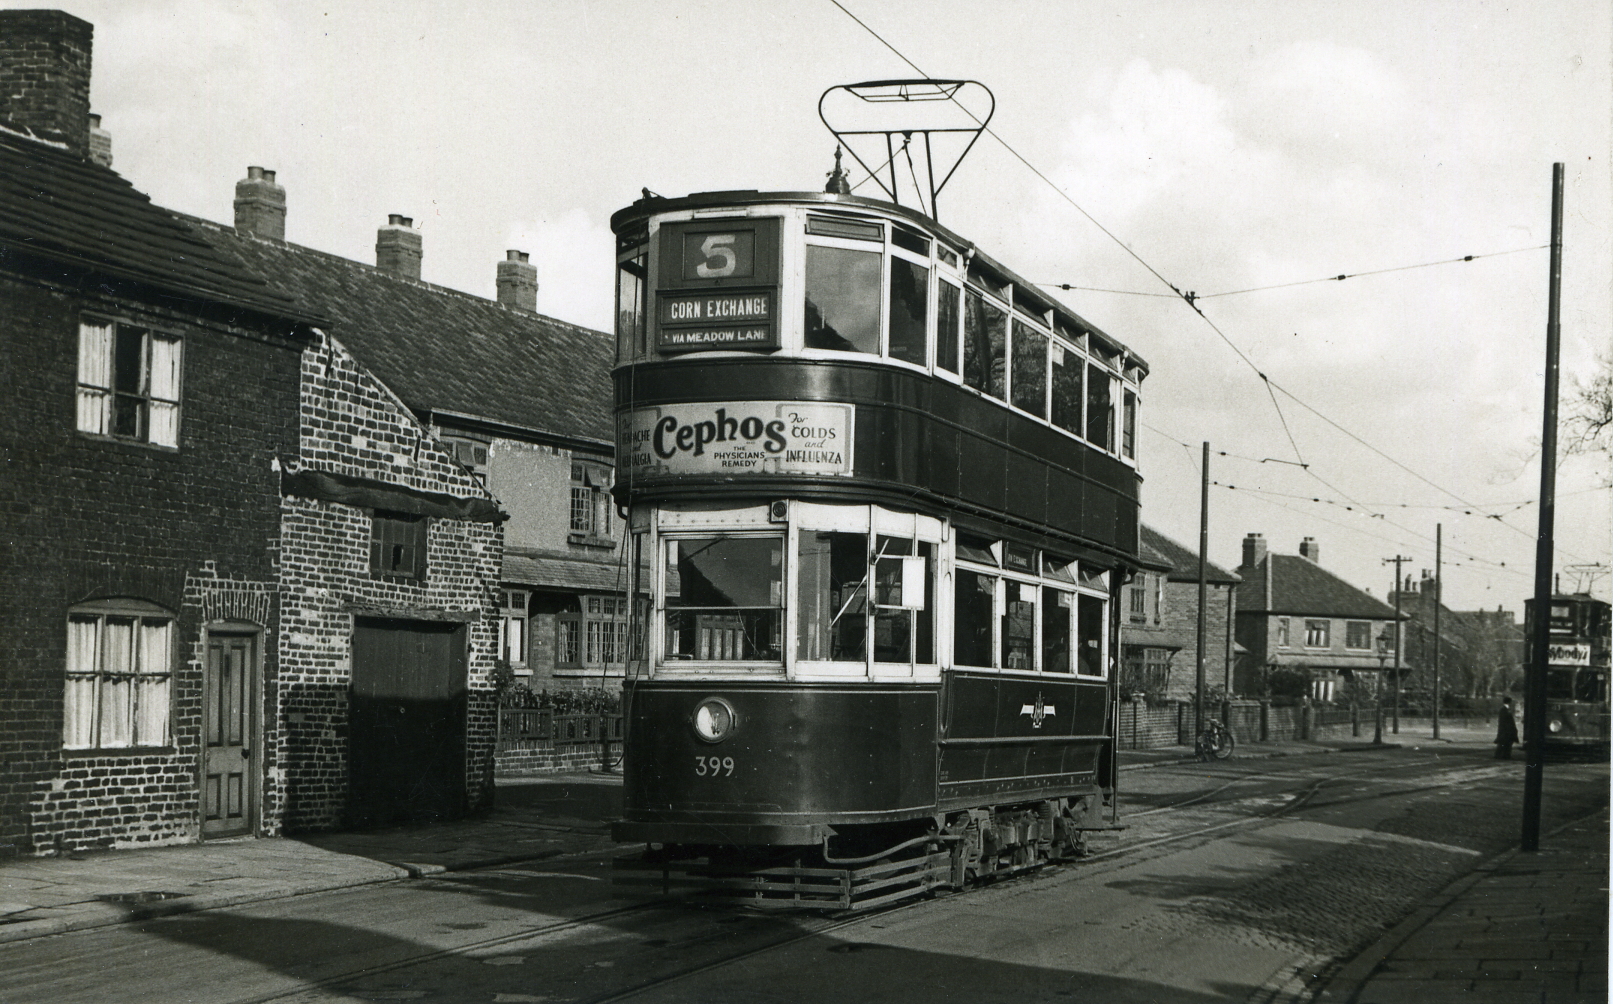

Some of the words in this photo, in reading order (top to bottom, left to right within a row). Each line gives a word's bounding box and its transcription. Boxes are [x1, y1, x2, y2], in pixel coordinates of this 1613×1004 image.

[696, 234, 736, 278] 5
[671, 300, 701, 319] CORN
[707, 297, 768, 318] EXCHANGE
[672, 332, 685, 343] VIA
[687, 330, 735, 343] MEADOW
[788, 412, 809, 424] For
[653, 407, 787, 460] Cephos
[791, 425, 836, 440] COLDS
[804, 438, 827, 449] and
[713, 451, 766, 460] PHYSICIANS
[785, 449, 843, 465] INFLUENZA
[721, 460, 757, 468] REMEDY
[695, 756, 735, 777] 399
